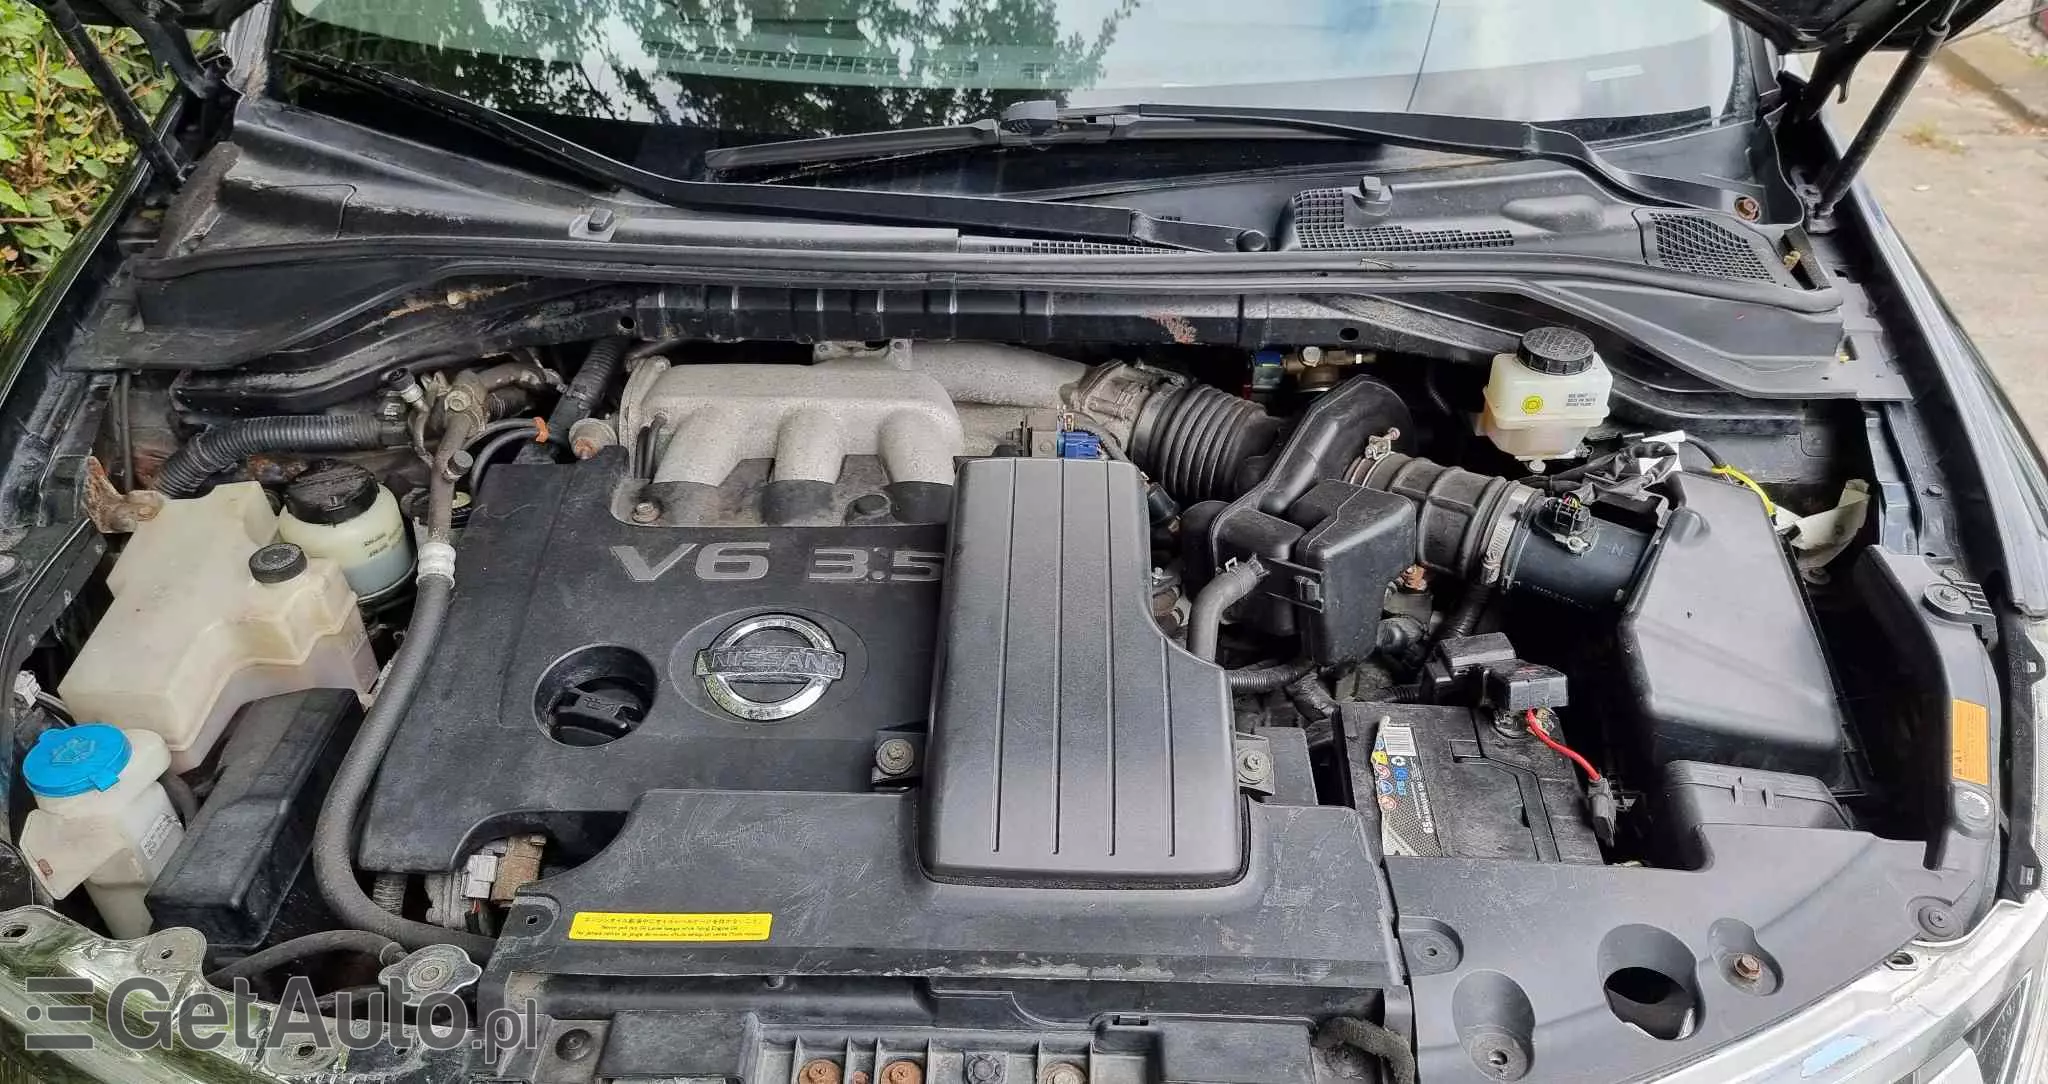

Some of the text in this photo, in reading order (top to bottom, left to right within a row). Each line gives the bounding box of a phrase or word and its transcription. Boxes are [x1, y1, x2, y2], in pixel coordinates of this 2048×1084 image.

[609, 542, 944, 582] V6 3.5
[711, 651, 829, 673] NISSAN
